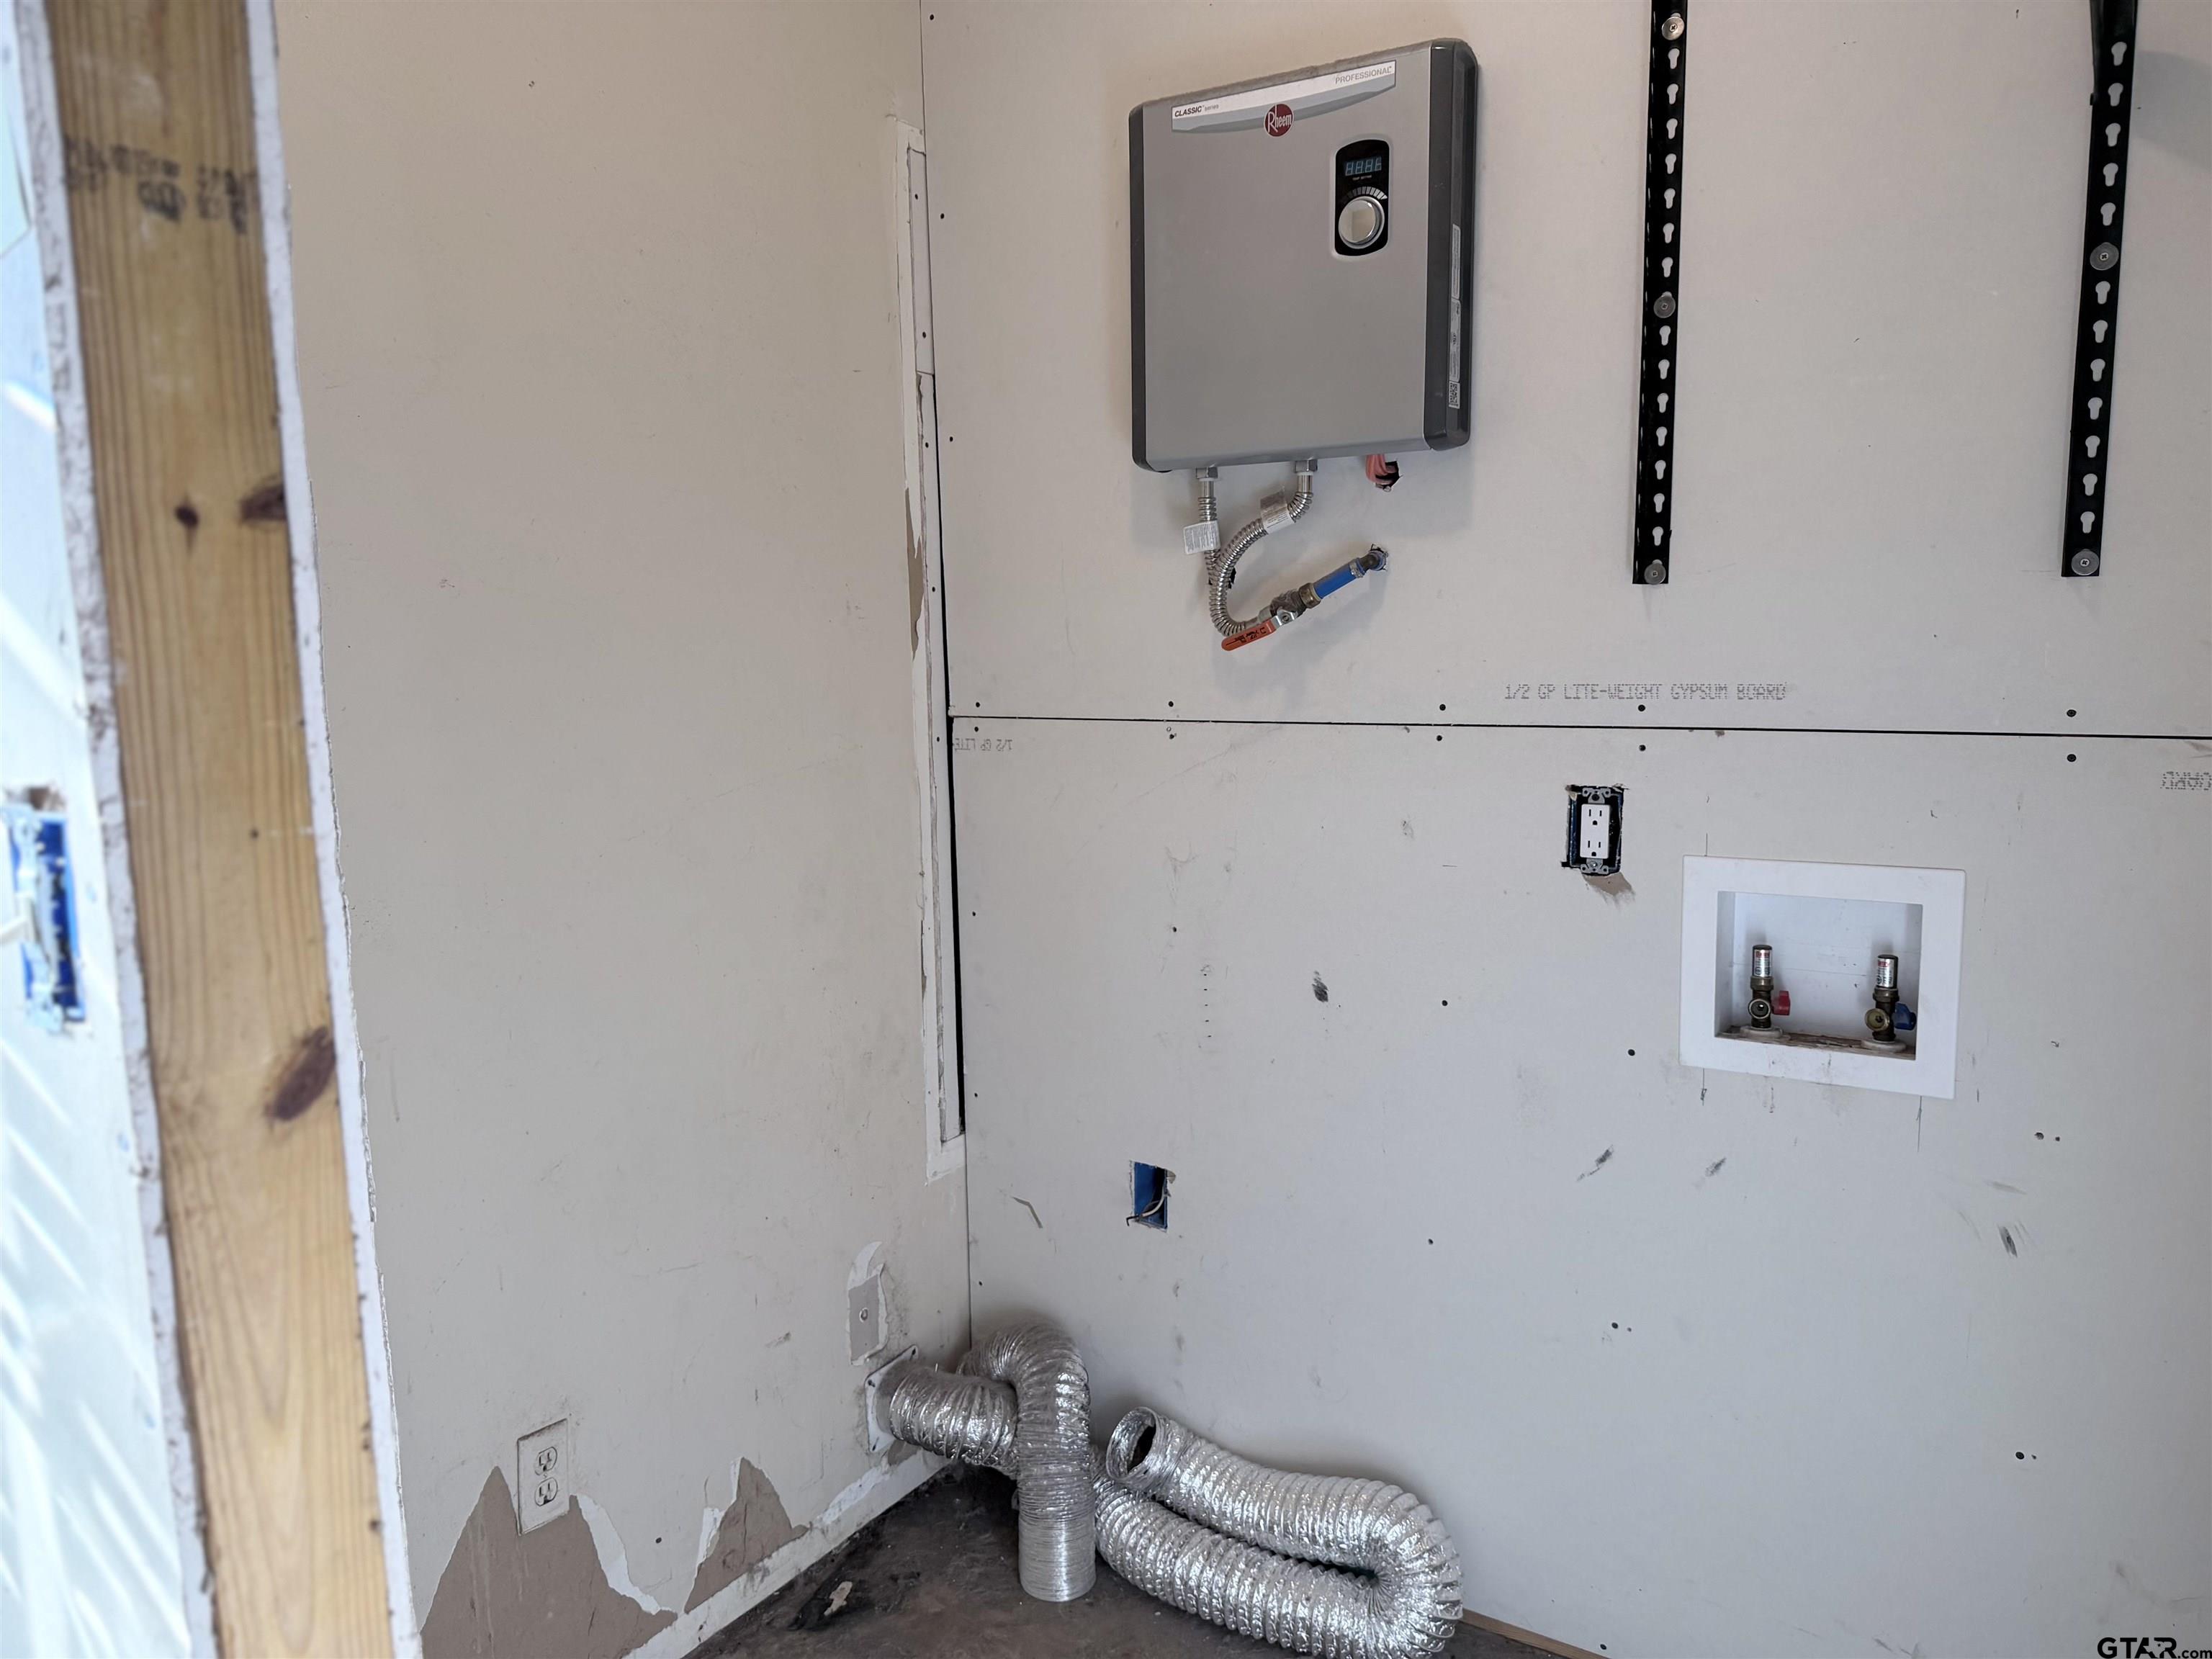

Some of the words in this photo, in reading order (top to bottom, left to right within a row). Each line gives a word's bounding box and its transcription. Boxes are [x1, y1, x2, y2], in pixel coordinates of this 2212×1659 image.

[1335, 66, 1391, 84] PROFESSIONAL
[1174, 105, 1202, 117] CLASSIC
[1267, 104, 1292, 133] Rheem
[1505, 684, 1530, 700] 1/2
[1538, 684, 1555, 700] GP
[1564, 683, 1663, 700] LITE-WEIGHT
[1671, 683, 1727, 700] GYPSUM
[1737, 683, 1786, 700] BOARD
